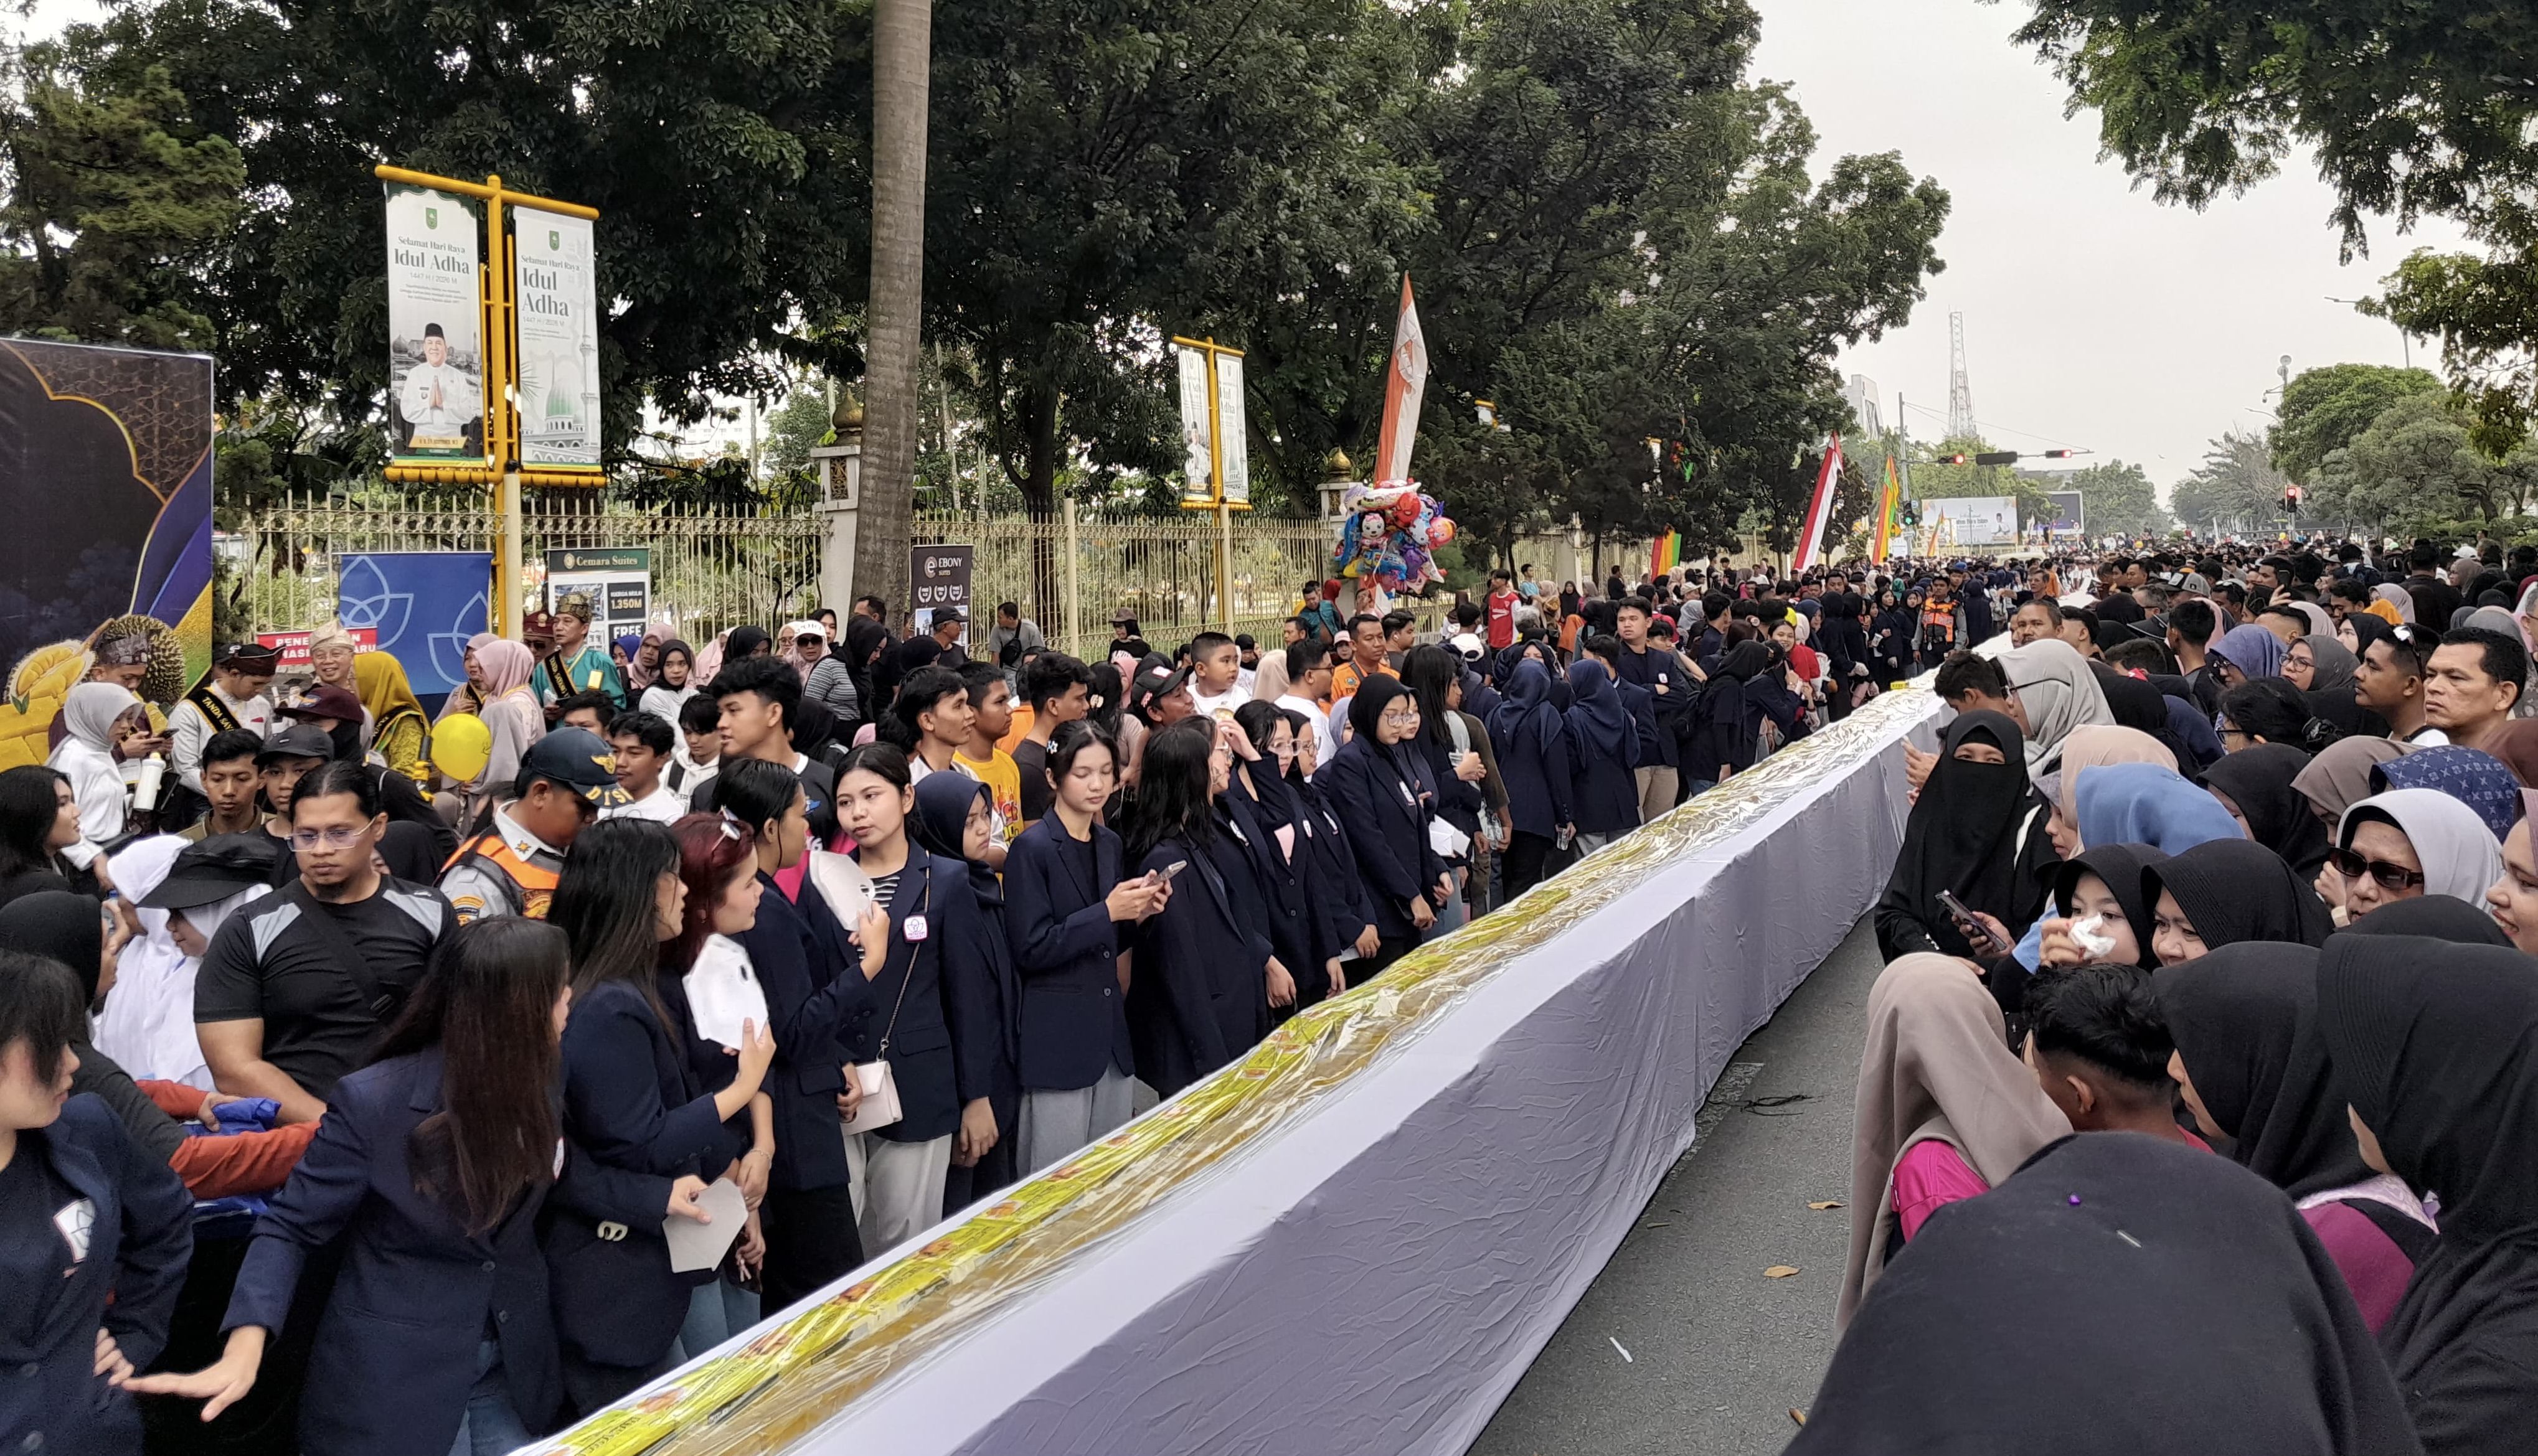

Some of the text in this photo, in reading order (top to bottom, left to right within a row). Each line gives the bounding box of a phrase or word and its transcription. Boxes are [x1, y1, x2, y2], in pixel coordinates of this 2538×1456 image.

[398, 236, 466, 255] Selamat Hari Raya
[394, 248, 469, 275] Idul Adha
[521, 255, 547, 266] Selamat
[564, 262, 580, 271] Raya
[523, 268, 557, 291] Idul
[522, 293, 569, 317] Adha
[577, 555, 638, 566] Cemara Suites
[938, 557, 963, 568] EBONY
[202, 697, 224, 719] TANDA
